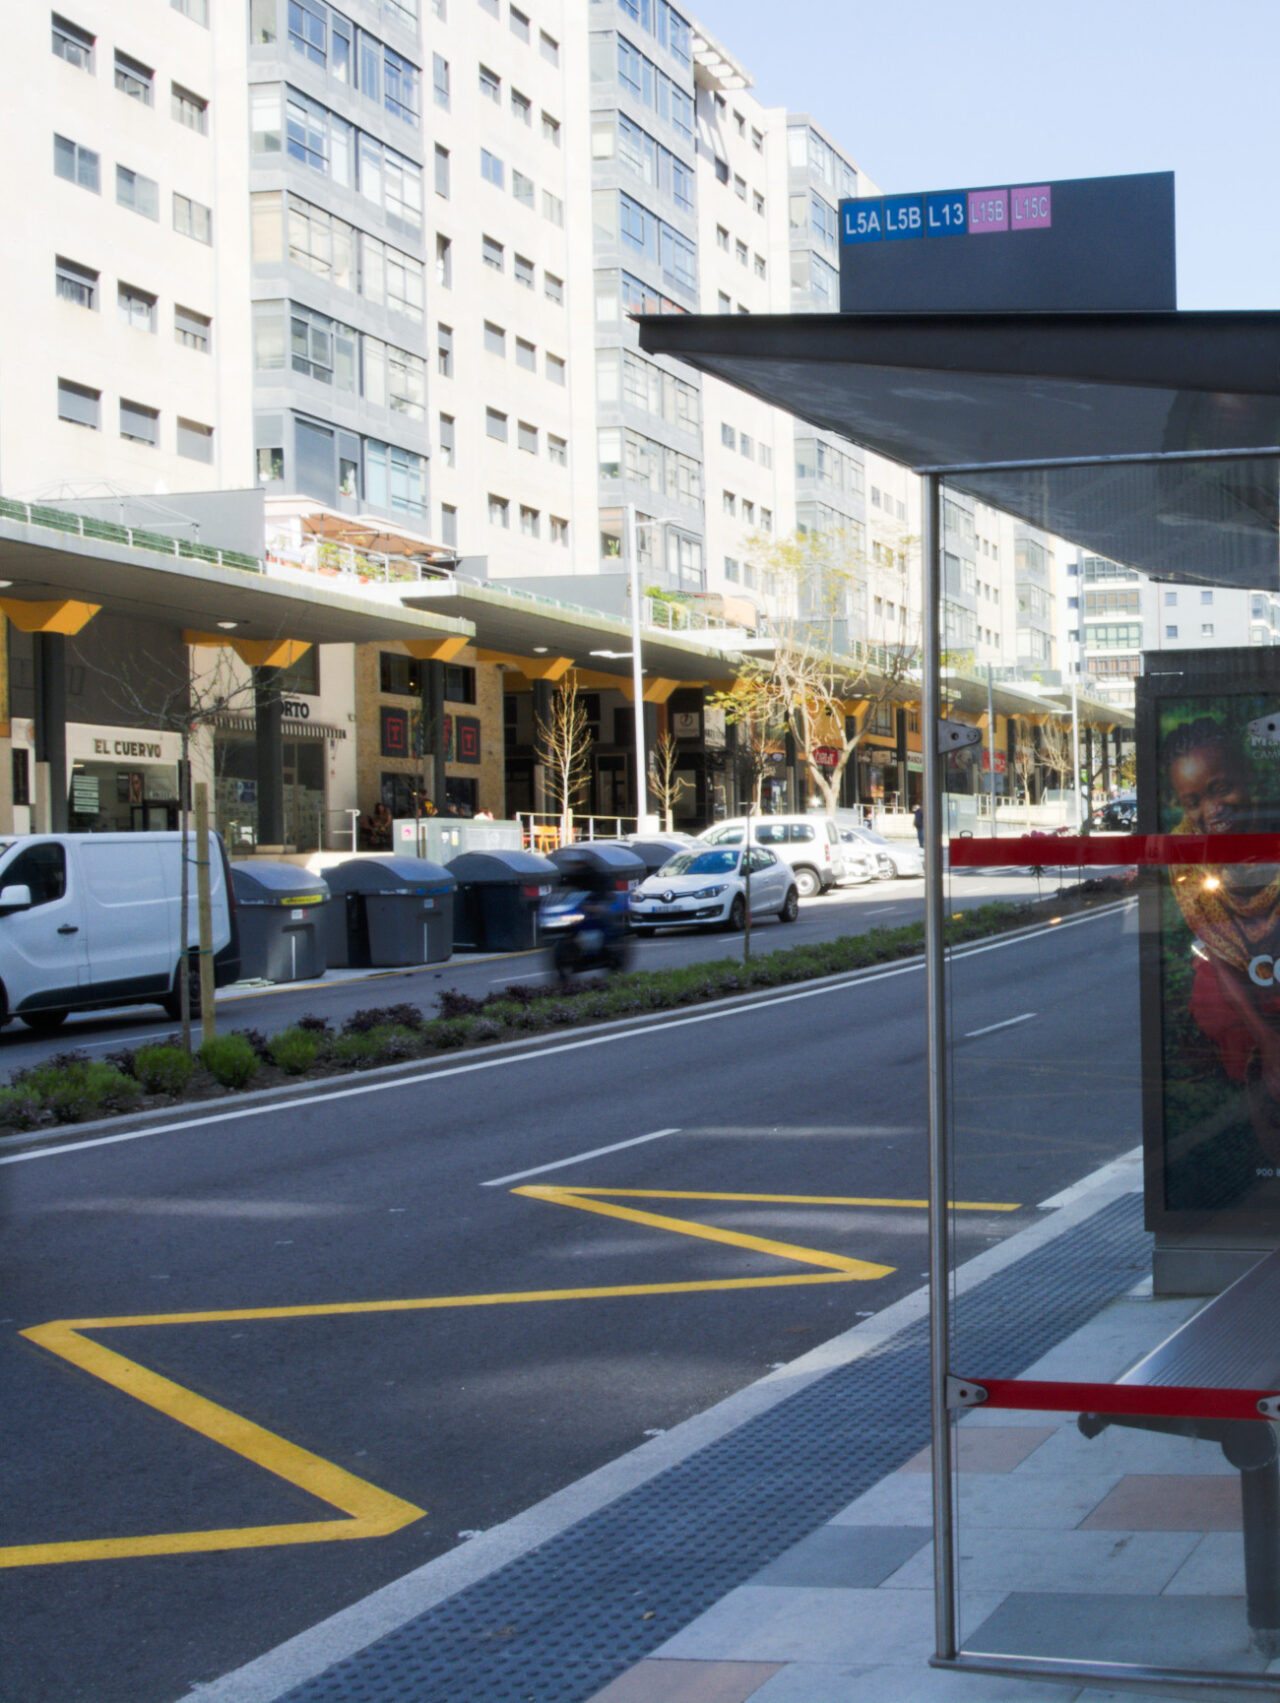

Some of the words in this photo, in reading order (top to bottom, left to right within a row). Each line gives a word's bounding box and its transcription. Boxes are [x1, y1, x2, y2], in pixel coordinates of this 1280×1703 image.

[845, 211, 881, 235] L5A
[886, 207, 921, 231] L5B
[928, 203, 964, 227] L13
[971, 200, 1005, 224] L15B
[1014, 196, 1048, 220] L15C
[95, 738, 111, 754] EL
[114, 740, 162, 758] CUERVO
